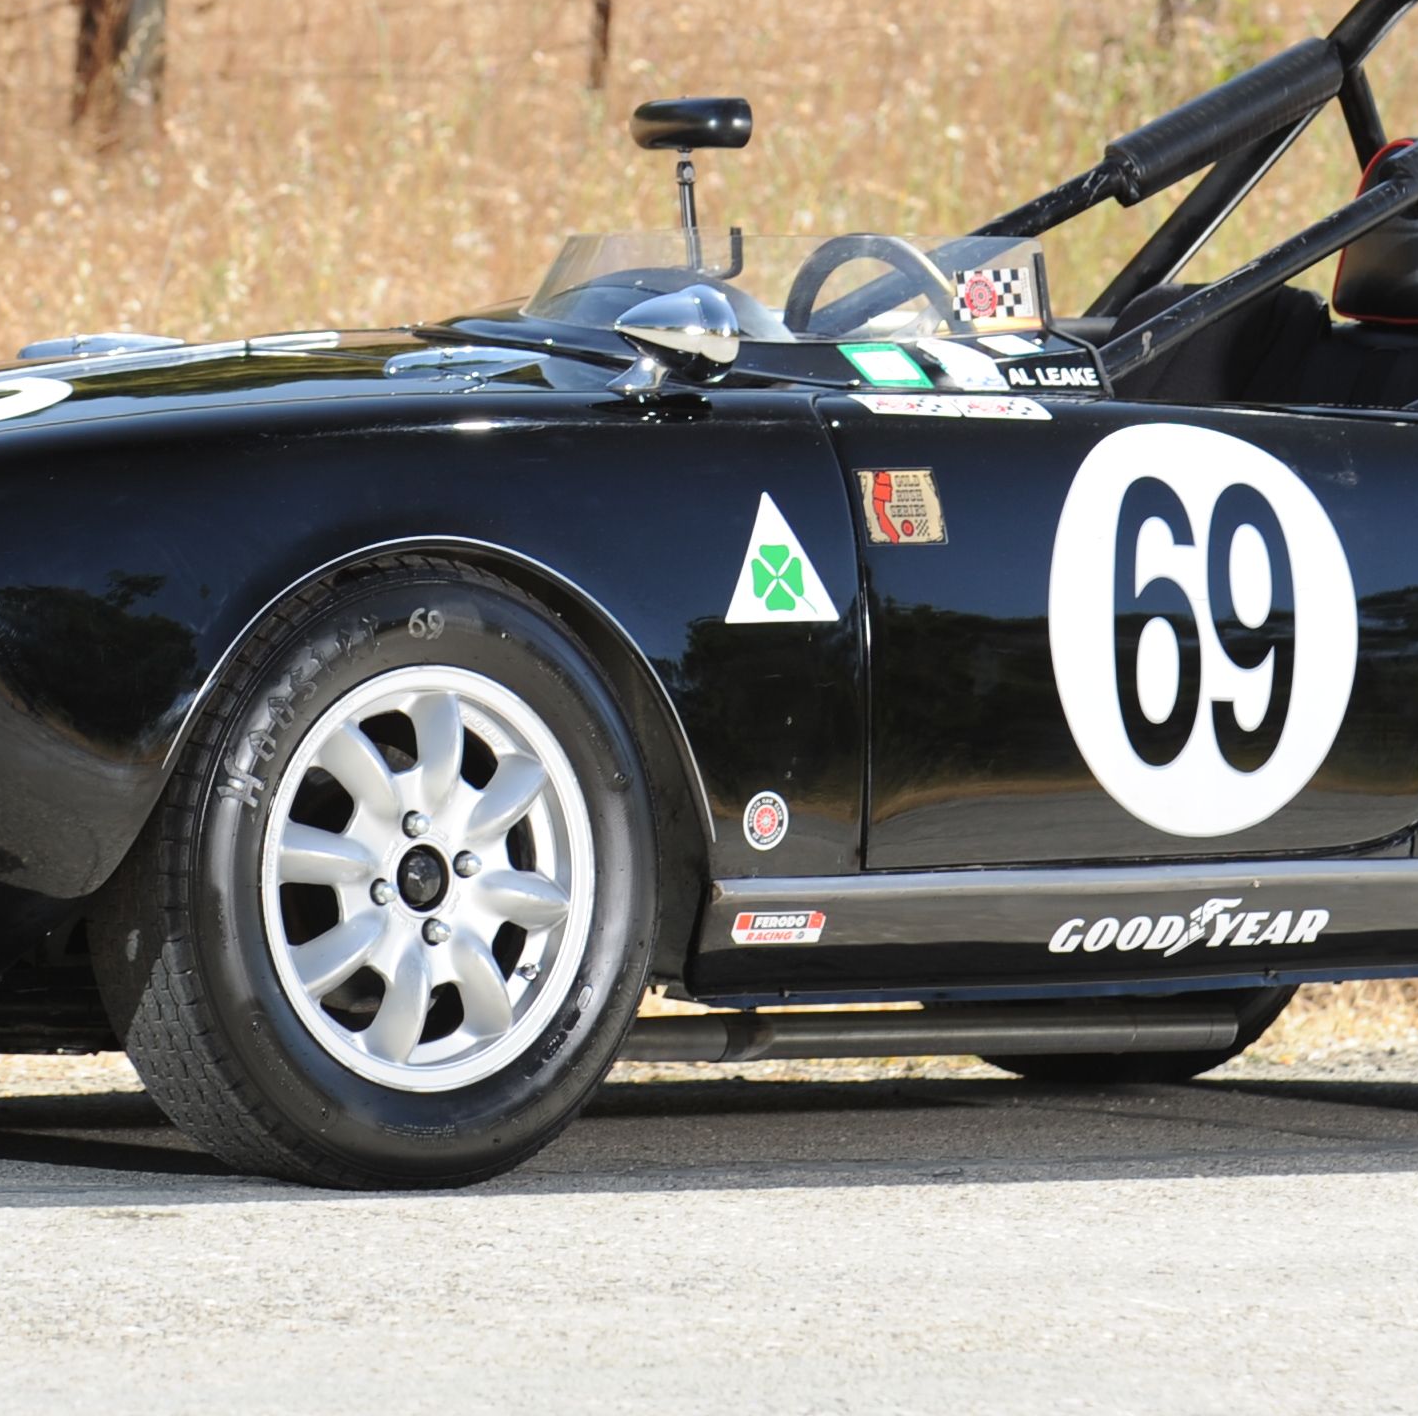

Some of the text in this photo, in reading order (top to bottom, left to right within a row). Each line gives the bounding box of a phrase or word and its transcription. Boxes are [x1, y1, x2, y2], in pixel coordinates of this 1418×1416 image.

[1007, 367, 1036, 386] AL
[1036, 367, 1100, 386] LEAKE
[889, 504, 927, 518] SERIES
[407, 606, 445, 641] 69
[1114, 475, 1298, 774] 69
[753, 915, 807, 929] FERODO
[745, 930, 794, 941] RACING
